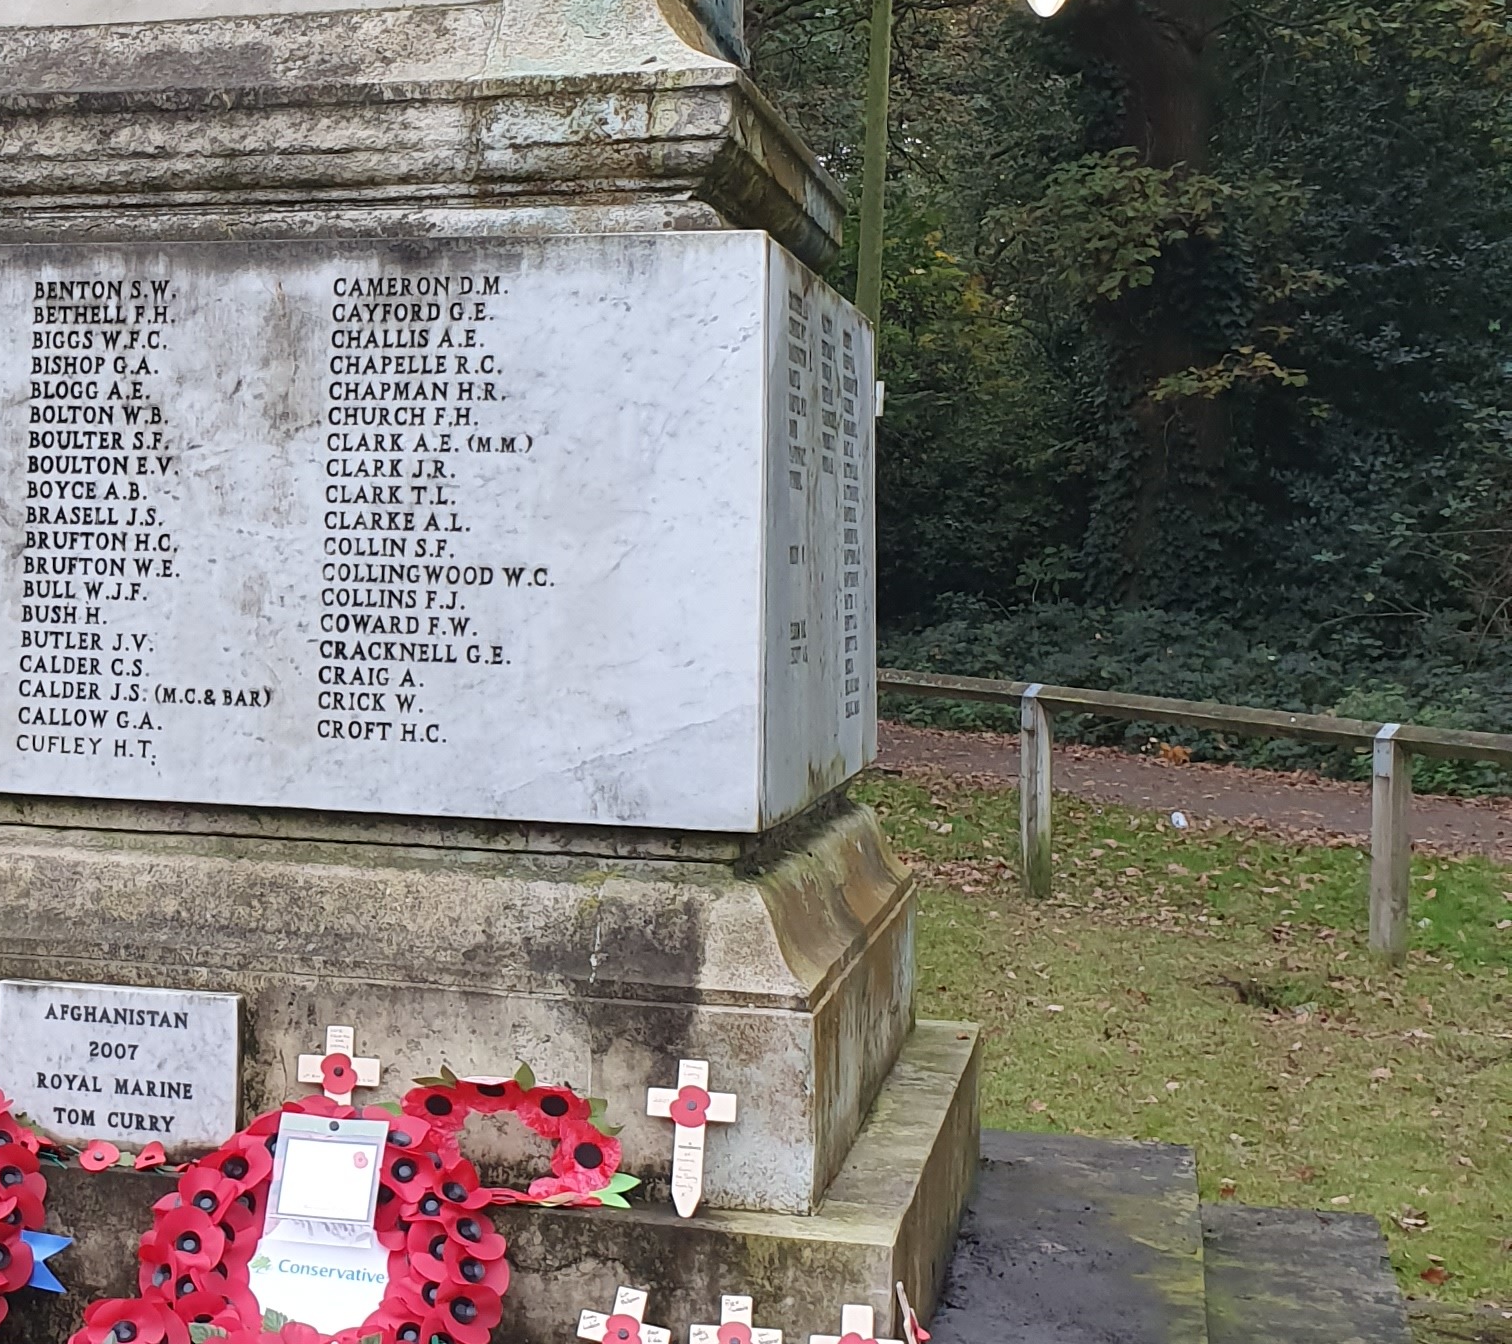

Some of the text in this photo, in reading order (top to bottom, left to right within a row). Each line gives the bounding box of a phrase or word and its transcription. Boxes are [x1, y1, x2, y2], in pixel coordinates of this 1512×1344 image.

[32, 279, 177, 301] BENTON S.W.
[333, 275, 509, 296] CAMERON D.M.
[332, 301, 495, 325] CAYFORD G.E.
[31, 329, 168, 351] BIGGS W.F.C.
[331, 330, 485, 350] CHALLIS A.E.
[329, 354, 503, 376] CHAPELLE R.C.
[28, 404, 169, 426] BOLTON W.B.
[327, 406, 479, 428] CHURCH F.H.
[326, 432, 534, 454] CLARK A.E. (M.M.)
[26, 454, 181, 477] BOULTON E.V.
[325, 458, 456, 480] CLARK J.R.
[25, 480, 148, 502] BOYCE A.B.
[323, 510, 471, 533] CLARKE A.L.
[323, 536, 455, 559] COLLIN S.F.
[22, 555, 181, 578] BRUFTON W.E.
[321, 562, 555, 588] COLLINGWOOD W.C.
[22, 579, 148, 601] BULL W.J.F.
[321, 587, 466, 611] COLLINS F.J.
[20, 605, 108, 625] BUSH H.
[320, 613, 478, 638] COWARD F.W.
[319, 639, 511, 666] CRACKNELL G.E.
[19, 654, 150, 678] CALDER C.S.
[317, 665, 424, 688] CRAIG A.
[18, 678, 271, 709] CALDER J.S. (M.C.& BAR)
[317, 690, 424, 714] CRICK W.
[17, 706, 163, 731] CALLOW G.A.
[317, 719, 447, 744] CROFT H.C.
[44, 1003, 189, 1029] AFGHANISTAN
[89, 1041, 139, 1060] 2007
[36, 1072, 193, 1100] ROYAL MARINE
[54, 1107, 175, 1133] TOM CURRY
[278, 1258, 385, 1284] Conservative
